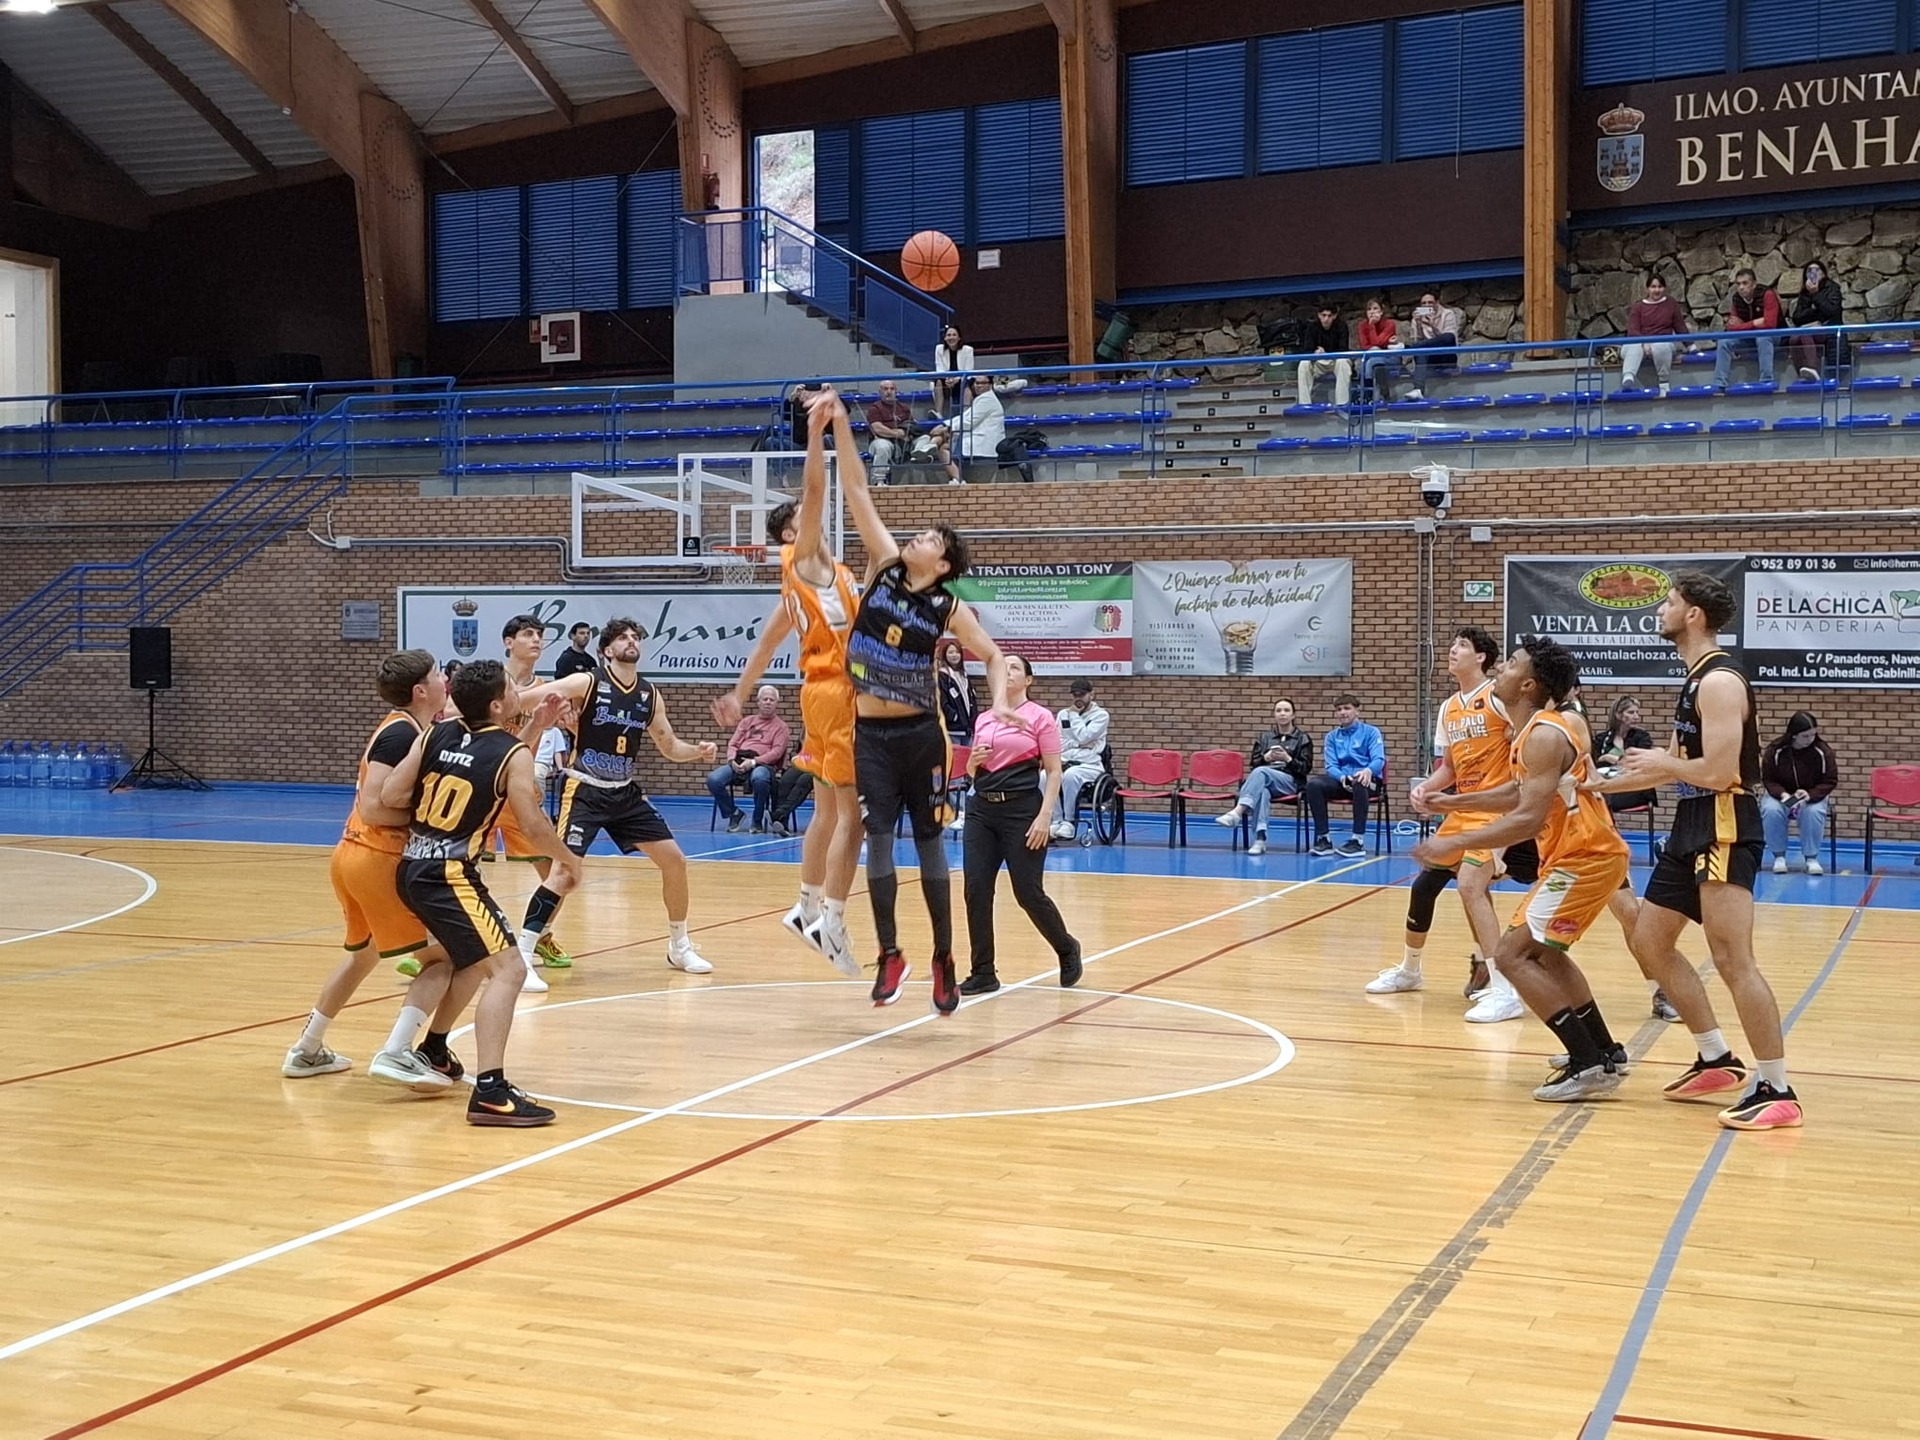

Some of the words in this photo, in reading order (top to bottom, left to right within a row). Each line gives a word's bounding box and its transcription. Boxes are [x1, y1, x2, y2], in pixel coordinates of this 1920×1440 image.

[1674, 87, 1765, 122] ILMO.
[1773, 68, 1920, 111] AYUNTA
[976, 565, 1054, 576] TRATTORIA
[1056, 564, 1071, 575] DI
[1075, 563, 1113, 575] TONY
[1761, 559, 1783, 570] 952
[1787, 559, 1801, 570] 89
[1805, 558, 1818, 569] 01
[1821, 558, 1837, 569] 36
[1870, 558, 1920, 569] info@herm
[1162, 571, 1221, 593] ¿Quieres
[1225, 567, 1273, 585] ahorrar
[1276, 570, 1294, 579] en
[1294, 562, 1307, 580] tu
[1174, 597, 1219, 616] factura
[1222, 591, 1238, 608] de
[1241, 584, 1325, 609] electricidad?
[1530, 615, 1598, 633] VENTA
[1609, 615, 1632, 633] LA
[1756, 620, 1885, 633] PANADERIA
[659, 653, 719, 669] Paraiso
[724, 653, 791, 669] Naral
[1825, 653, 1889, 666] Panaderos,
[1578, 667, 1613, 676] ASARES
[1758, 666, 1779, 677] Pol.
[1782, 666, 1801, 678] Ind.
[1803, 667, 1817, 678] La
[1819, 667, 1870, 678] Dehesilla
[616, 736, 627, 754] 8
[415, 772, 473, 832] 10
